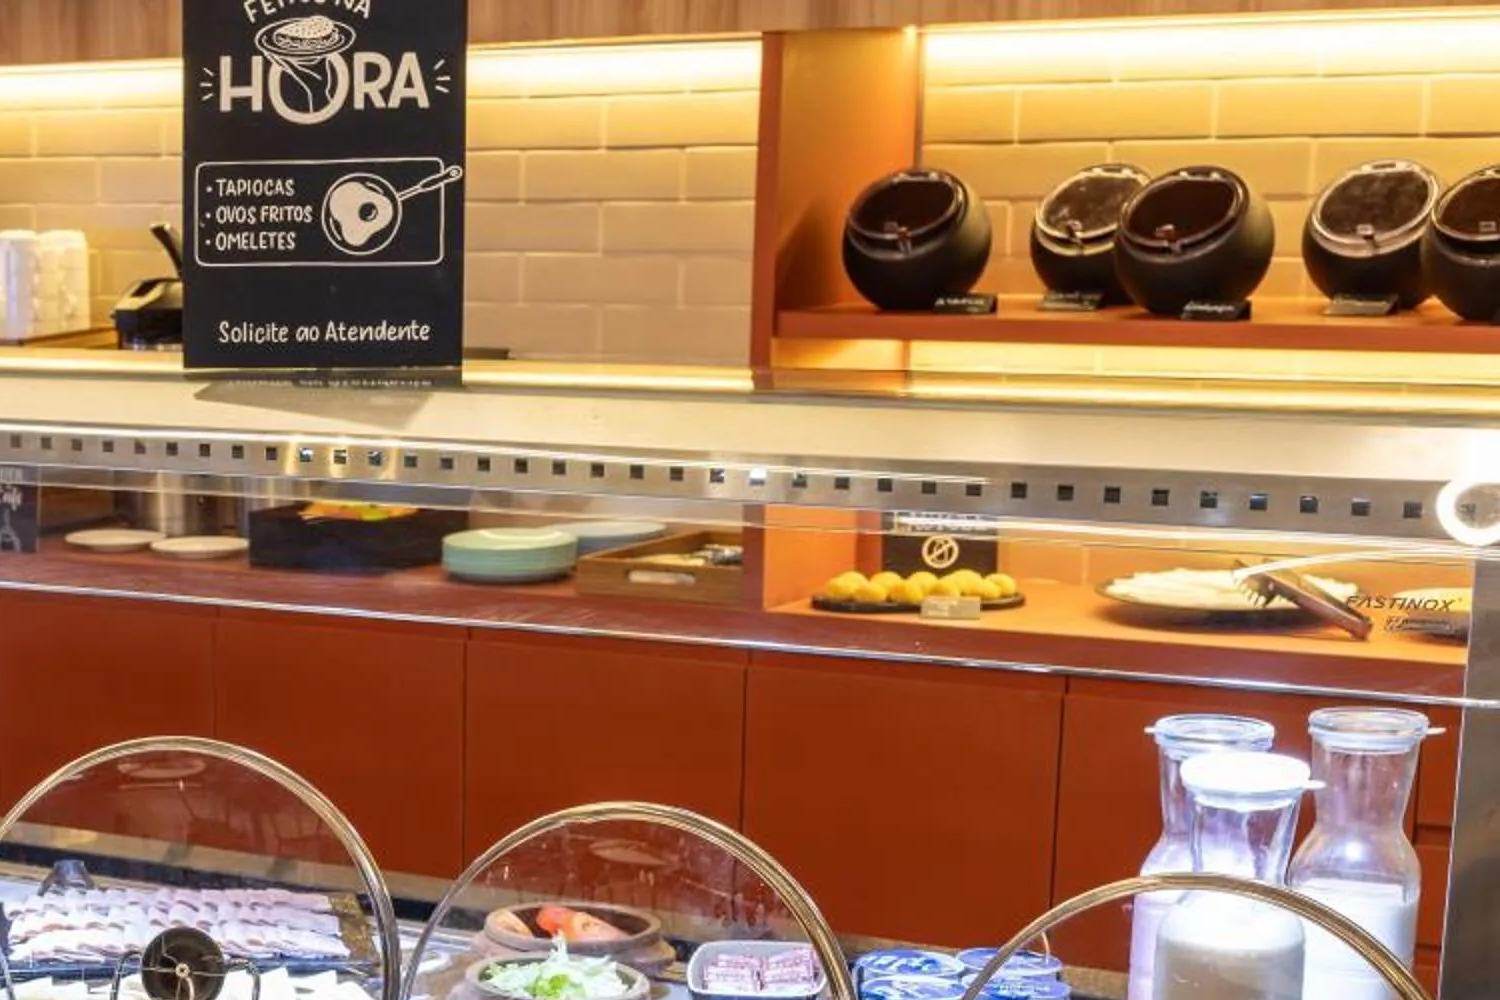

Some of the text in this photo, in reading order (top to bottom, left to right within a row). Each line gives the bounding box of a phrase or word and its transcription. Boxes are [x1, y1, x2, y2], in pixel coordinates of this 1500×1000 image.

[219, 51, 430, 124] HORA
[216, 179, 296, 198] TAPIOCAS
[215, 205, 314, 225] OVOS FRITOS
[215, 232, 297, 251] OMELETES
[218, 320, 431, 344] Solicite ao Atendente
[1347, 594, 1457, 612] FASTINOX
